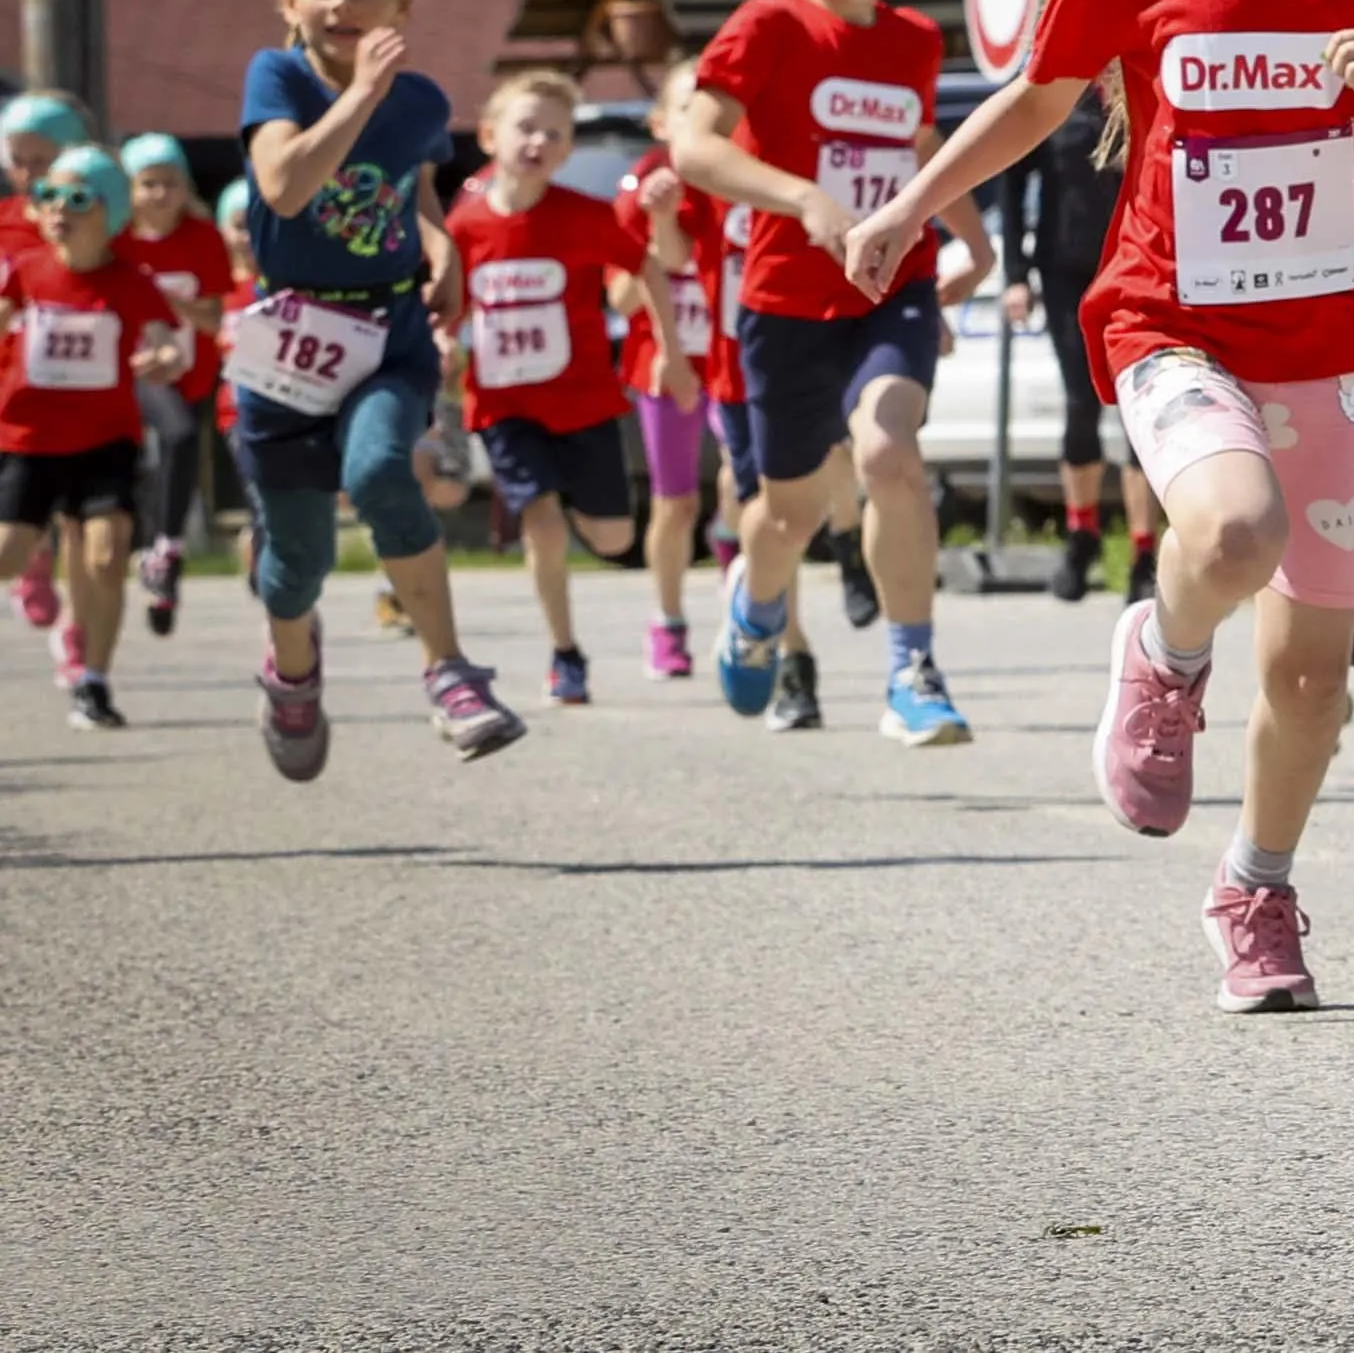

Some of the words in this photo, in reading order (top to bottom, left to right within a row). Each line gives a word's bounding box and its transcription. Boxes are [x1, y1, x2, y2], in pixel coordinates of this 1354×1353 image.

[1180, 54, 1324, 92] Dr.Max
[829, 92, 907, 124] Dr.Max
[1219, 181, 1316, 243] 287
[275, 329, 346, 383] 182
